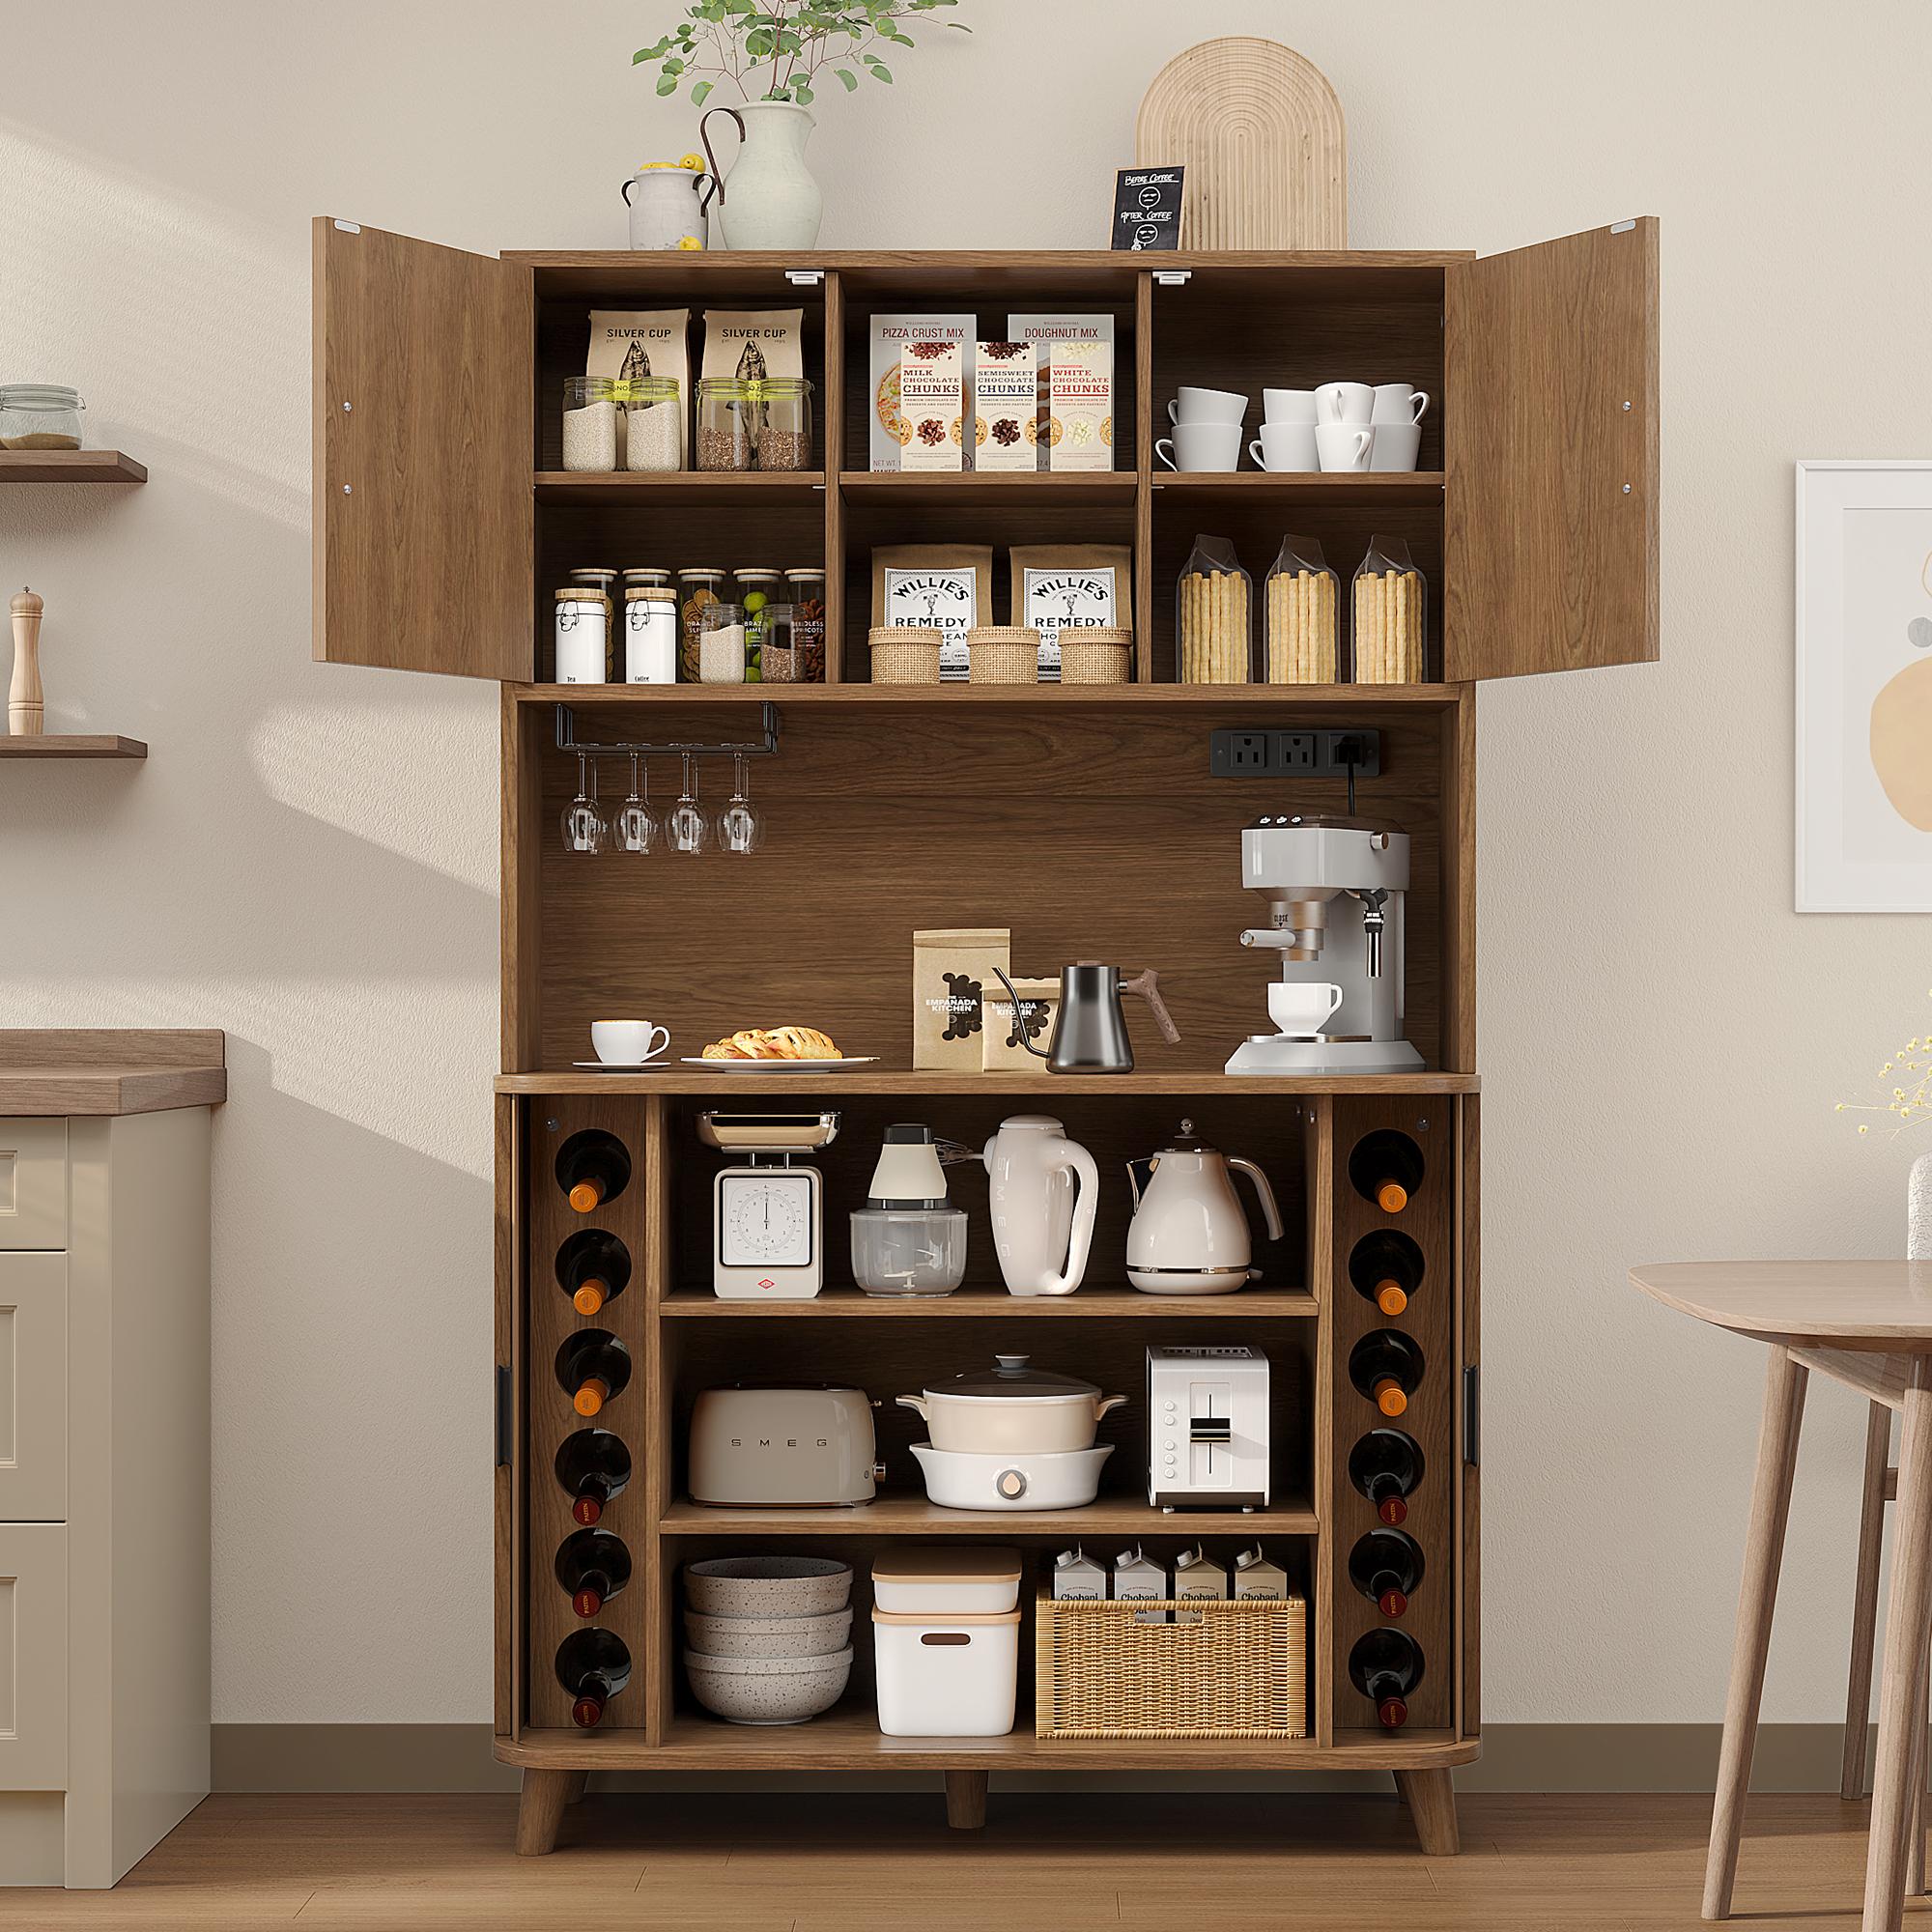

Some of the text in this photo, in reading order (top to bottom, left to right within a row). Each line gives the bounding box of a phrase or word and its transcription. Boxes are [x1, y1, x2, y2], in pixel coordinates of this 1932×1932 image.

[607, 328, 671, 338] SILVER CUP
[722, 328, 786, 338] SILVER CUP
[882, 327, 964, 338] PIZZA CRUST MIX
[1024, 327, 1098, 338] DOUGHNUT MIX
[903, 384, 959, 393] CHUNKS
[978, 384, 1034, 393] CHUNKS
[1053, 384, 1109, 393] CHUNKS
[893, 577, 969, 601] WILLIE'S
[1032, 577, 1108, 601] WILLIE'S
[895, 617, 967, 628] REMEDY
[1035, 617, 1107, 628] REMEDY
[731, 1438, 827, 1447] SMEG
[1061, 1592, 1098, 1601] Chobani
[1121, 1592, 1158, 1601] Chobani
[1181, 1592, 1219, 1601] Chobani
[1241, 1592, 1279, 1601] Chobani
